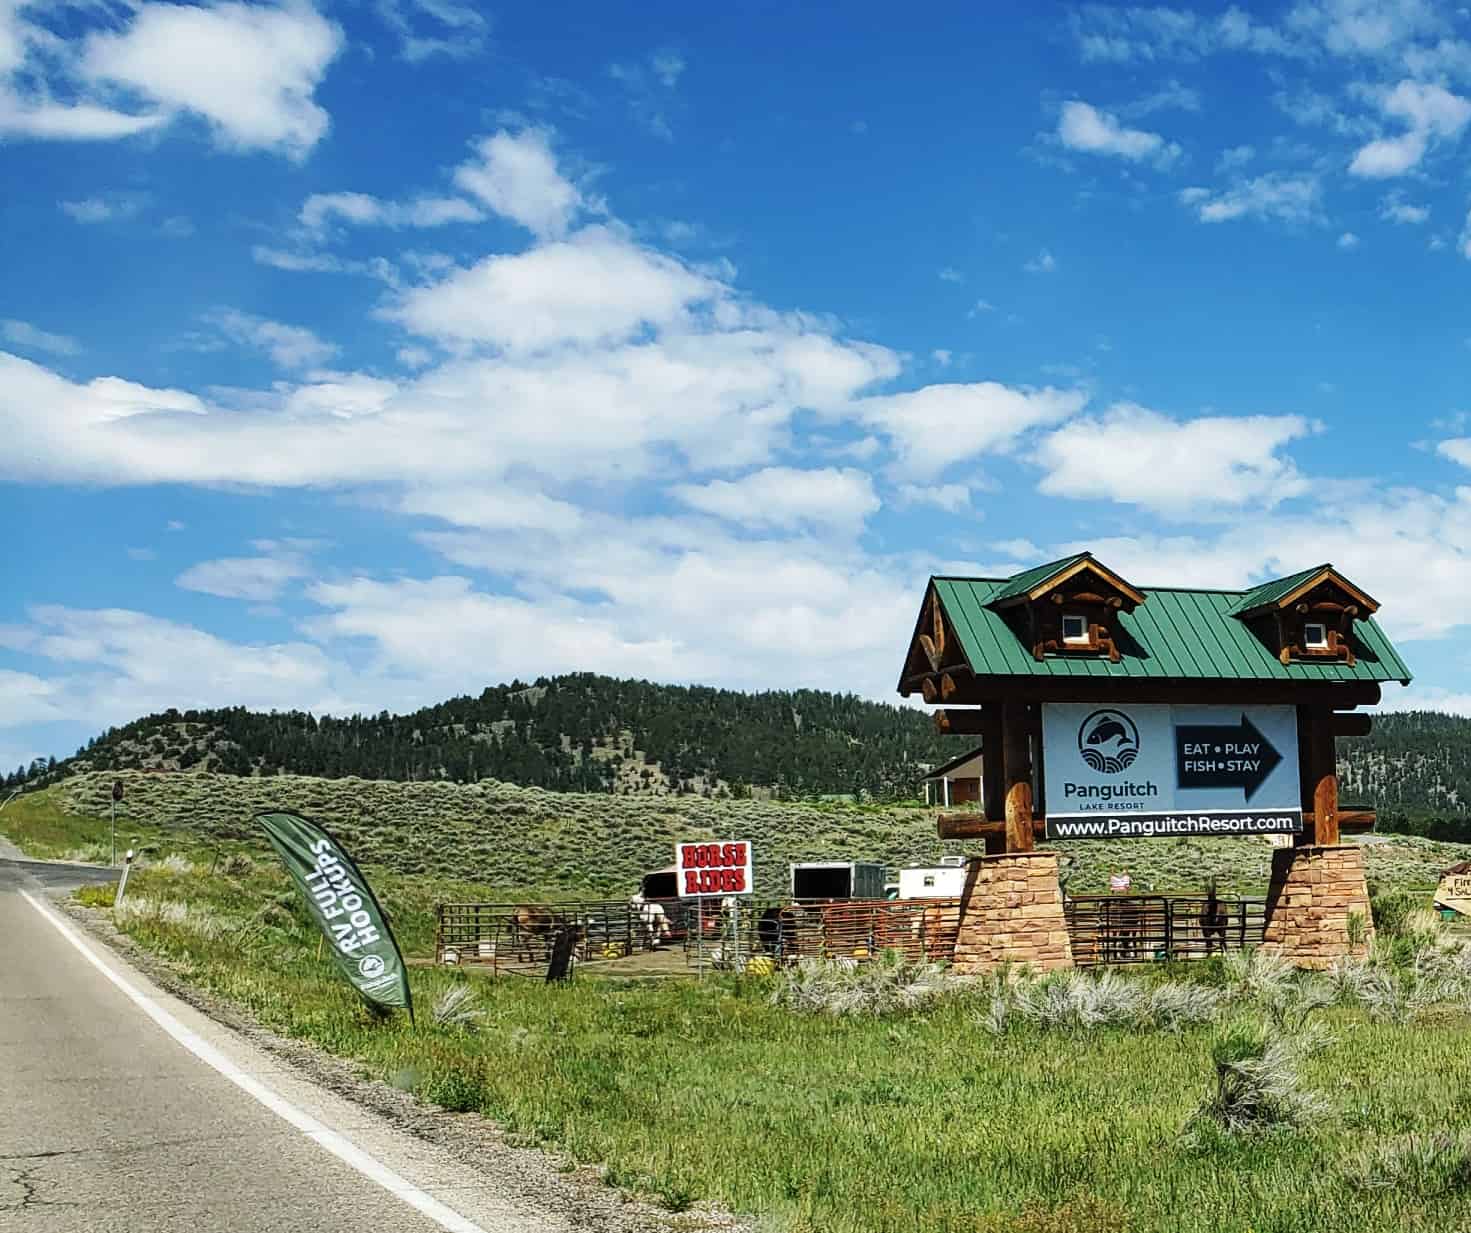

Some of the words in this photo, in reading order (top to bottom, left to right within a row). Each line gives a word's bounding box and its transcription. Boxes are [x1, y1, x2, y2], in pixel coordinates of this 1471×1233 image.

[1183, 743, 1210, 755] EAT
[1225, 743, 1260, 755] PLAY
[1184, 760, 1216, 772] FISH
[1226, 760, 1261, 772] STAY
[1064, 780, 1158, 801] Panguitch
[1079, 802, 1104, 810] LAKE
[1107, 801, 1145, 810] RESORT
[1056, 816, 1293, 836] www.PanguitchResort.com
[682, 844, 746, 868] HORSE
[305, 863, 344, 920] FULL
[310, 839, 380, 945] HOOKUPS
[686, 869, 744, 893] RIDES
[331, 922, 362, 953] RV
